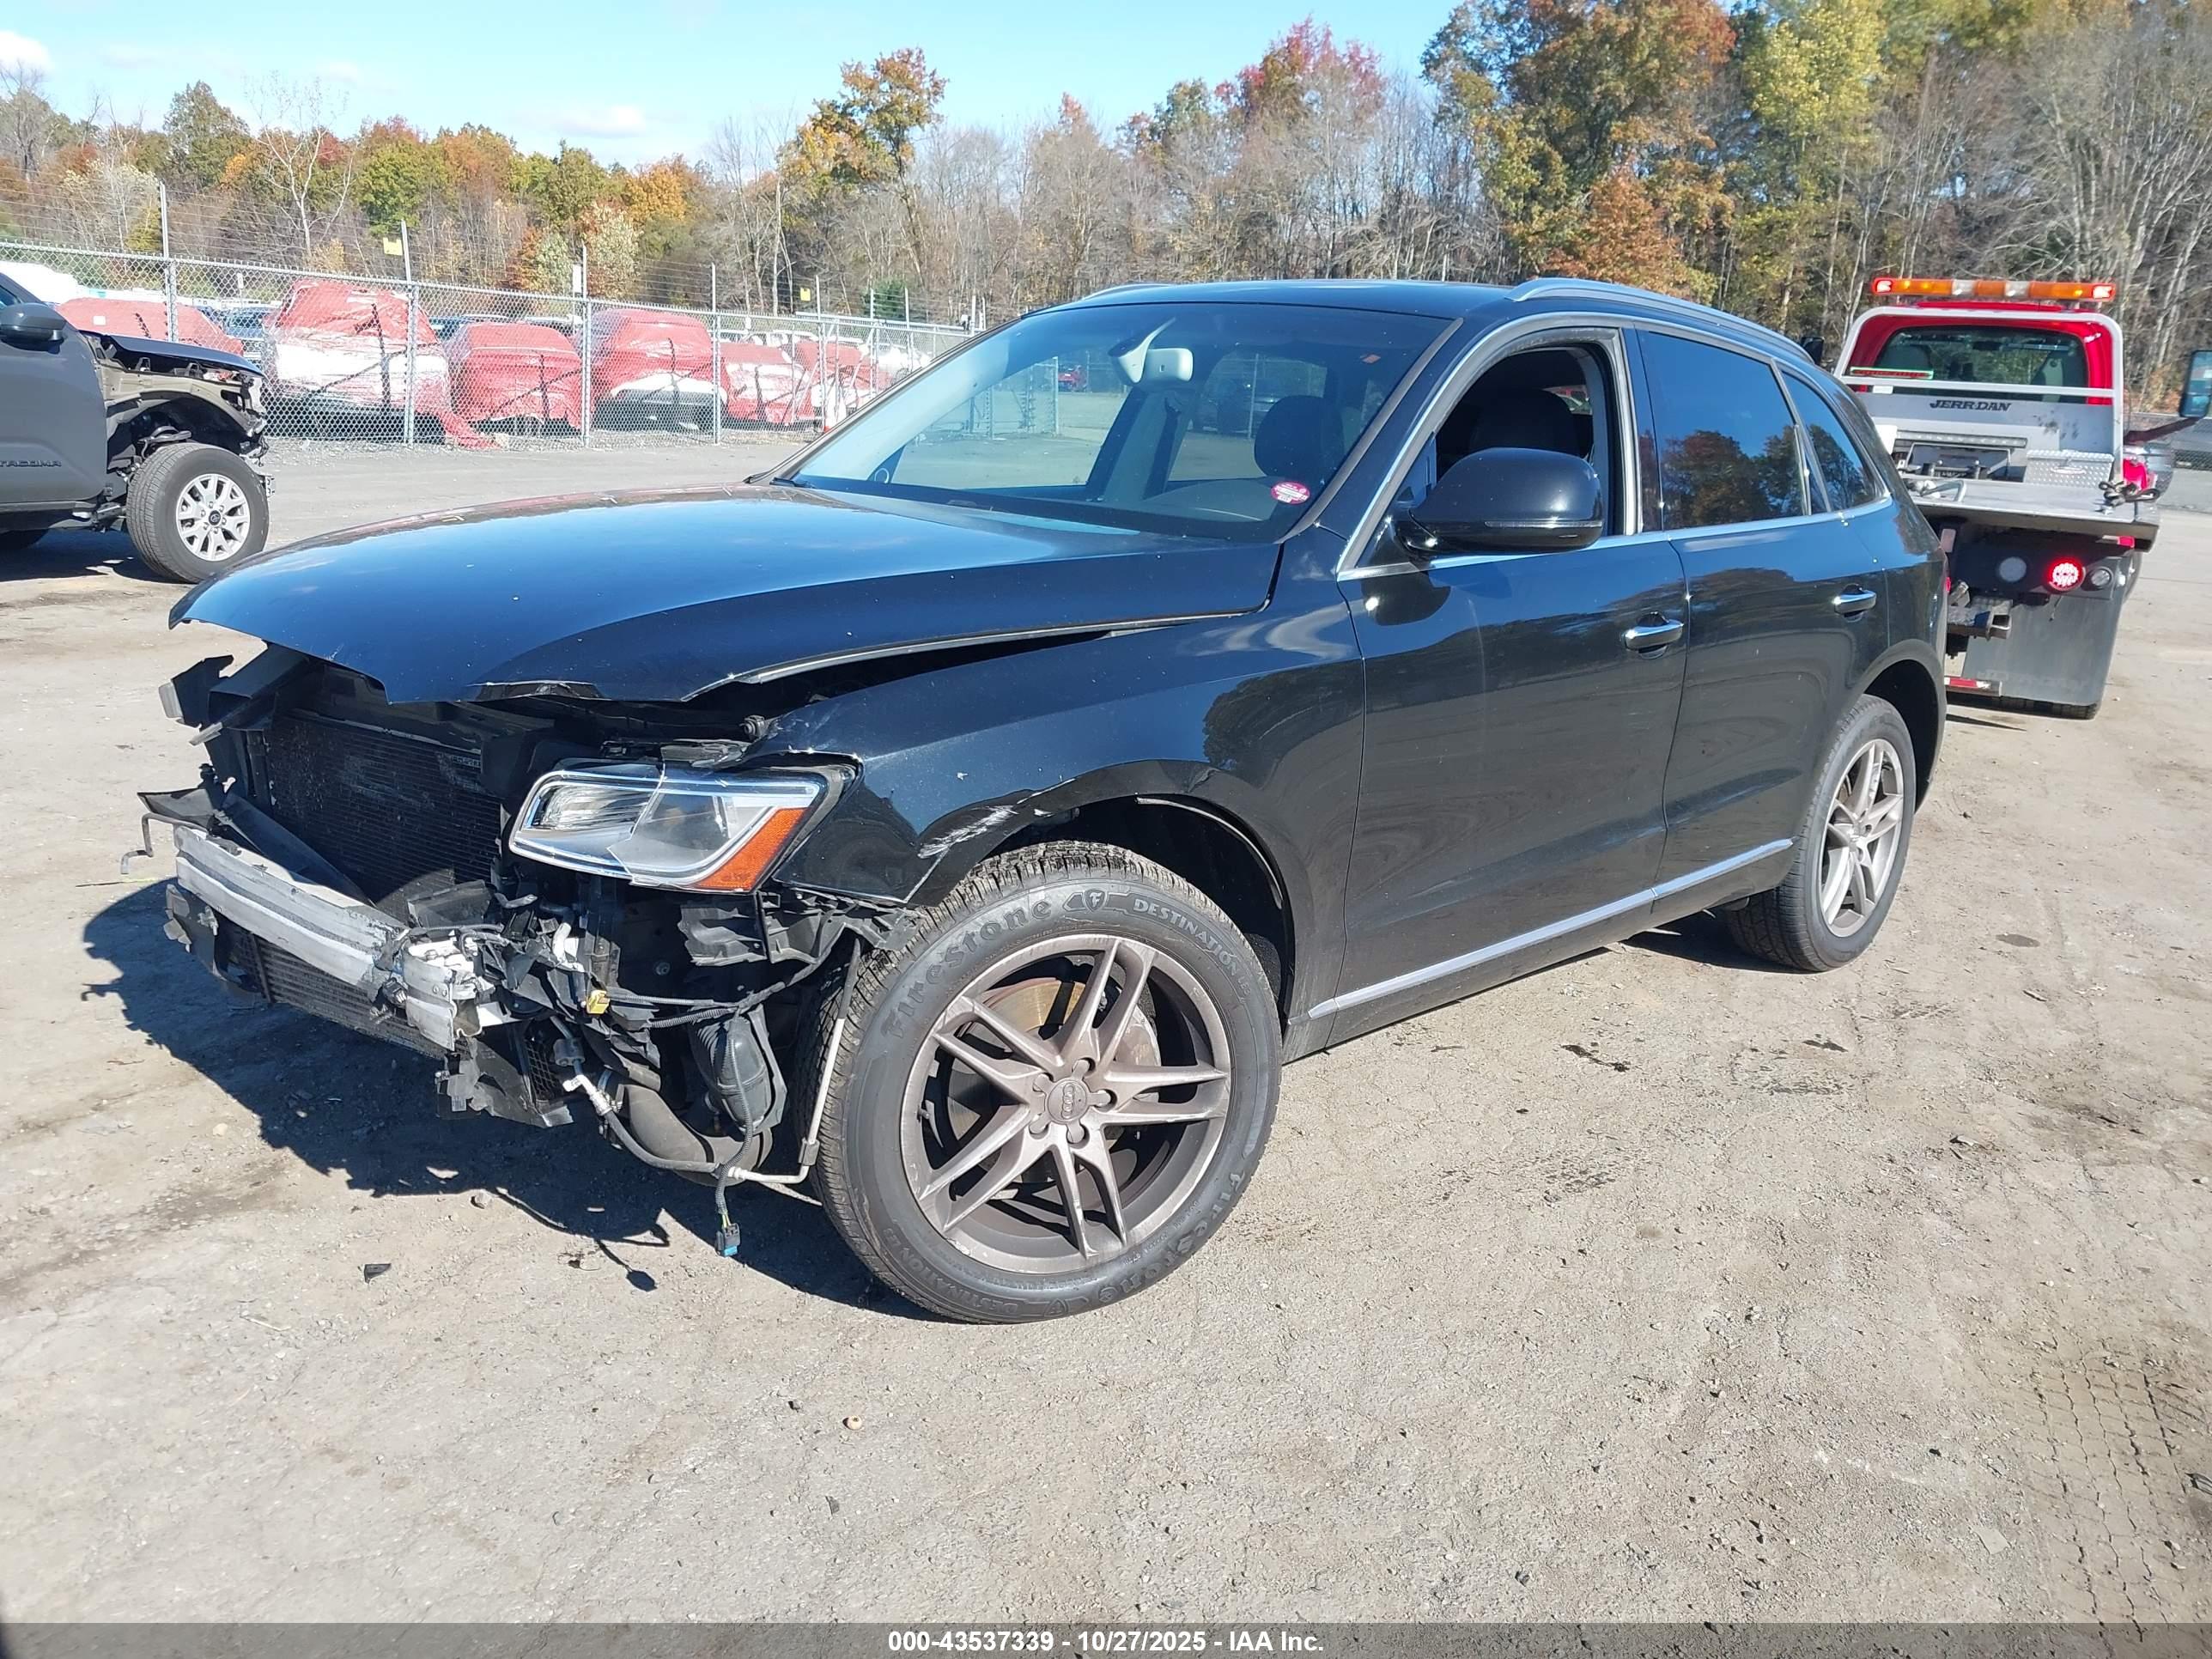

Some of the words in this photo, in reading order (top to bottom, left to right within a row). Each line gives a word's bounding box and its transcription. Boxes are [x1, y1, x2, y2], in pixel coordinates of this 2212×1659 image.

[880, 900, 1053, 1039] Firestone
[1133, 898, 1240, 976] DESTINATION
[901, 1247, 1018, 1313] DESTINATION
[1098, 1170, 1246, 1304] Firestone
